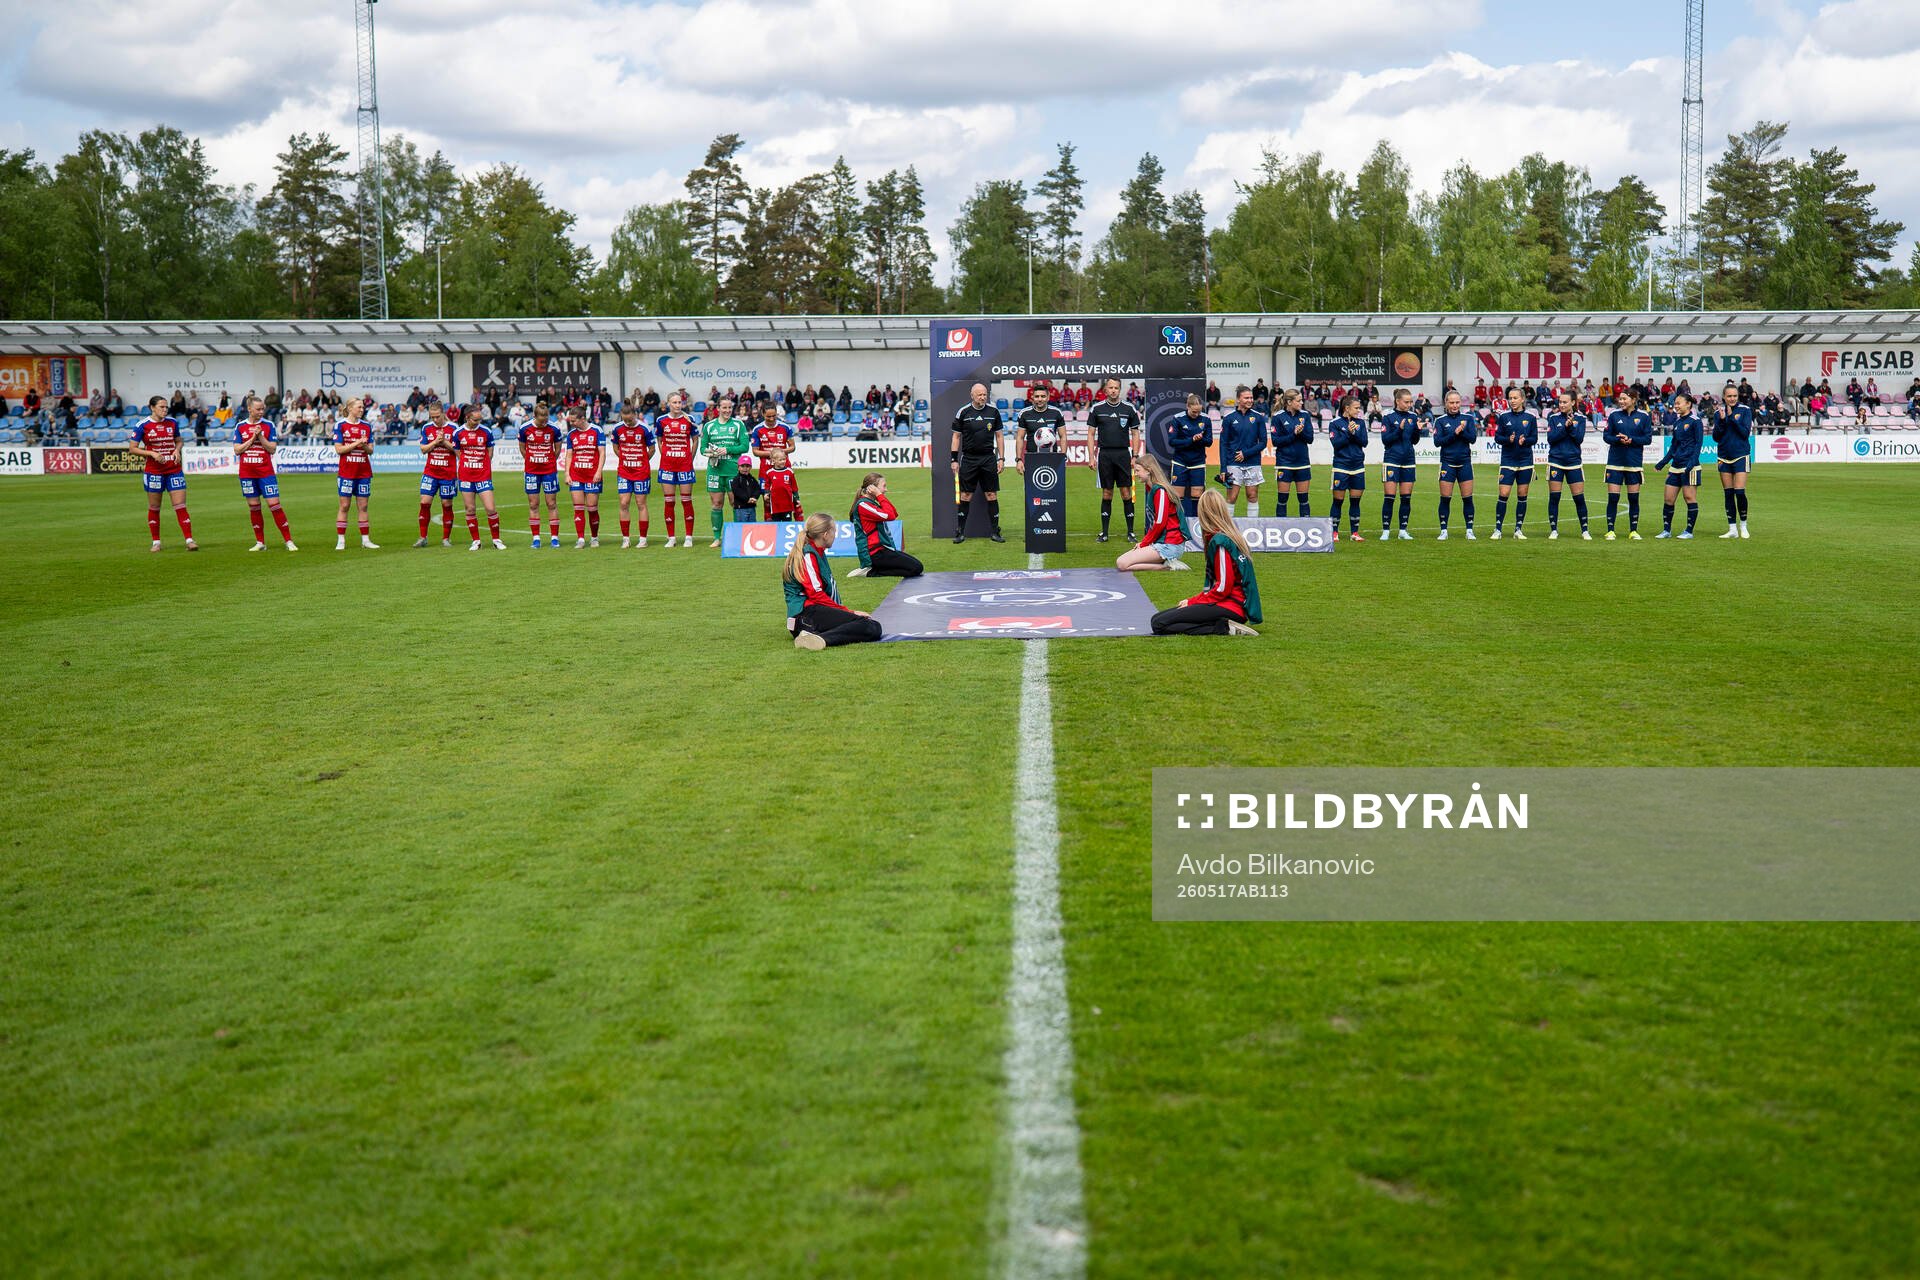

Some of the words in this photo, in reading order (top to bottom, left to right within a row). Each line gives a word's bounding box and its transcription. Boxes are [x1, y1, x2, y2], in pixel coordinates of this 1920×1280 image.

[938, 350, 966, 358] SVENSKA
[967, 350, 981, 358] SPEL
[1160, 346, 1193, 355] OBOS
[509, 357, 593, 373] KREATIV
[1207, 360, 1250, 368] kommun
[1299, 354, 1386, 366] Snapphanebygdens
[1475, 352, 1584, 379] NIBE
[1651, 356, 1743, 373] PEAB
[1841, 351, 1914, 369] FASAB
[716, 368, 758, 381] Omsorg
[991, 365, 1026, 375] OBOS
[1029, 364, 1143, 375] DAMALLSVENSKAN
[1341, 365, 1385, 378] Sparbank
[168, 381, 227, 389] SUNLIGHT
[511, 376, 590, 385] REKLAM
[1151, 390, 1181, 404] OBOS
[1794, 441, 1831, 455] VIDA
[49, 452, 82, 460] FARO
[103, 452, 119, 462] Jon
[849, 448, 921, 464] SVENSKA
[49, 461, 83, 470] ZON
[101, 461, 146, 471] Consultin
[1242, 528, 1324, 548] OBOS
